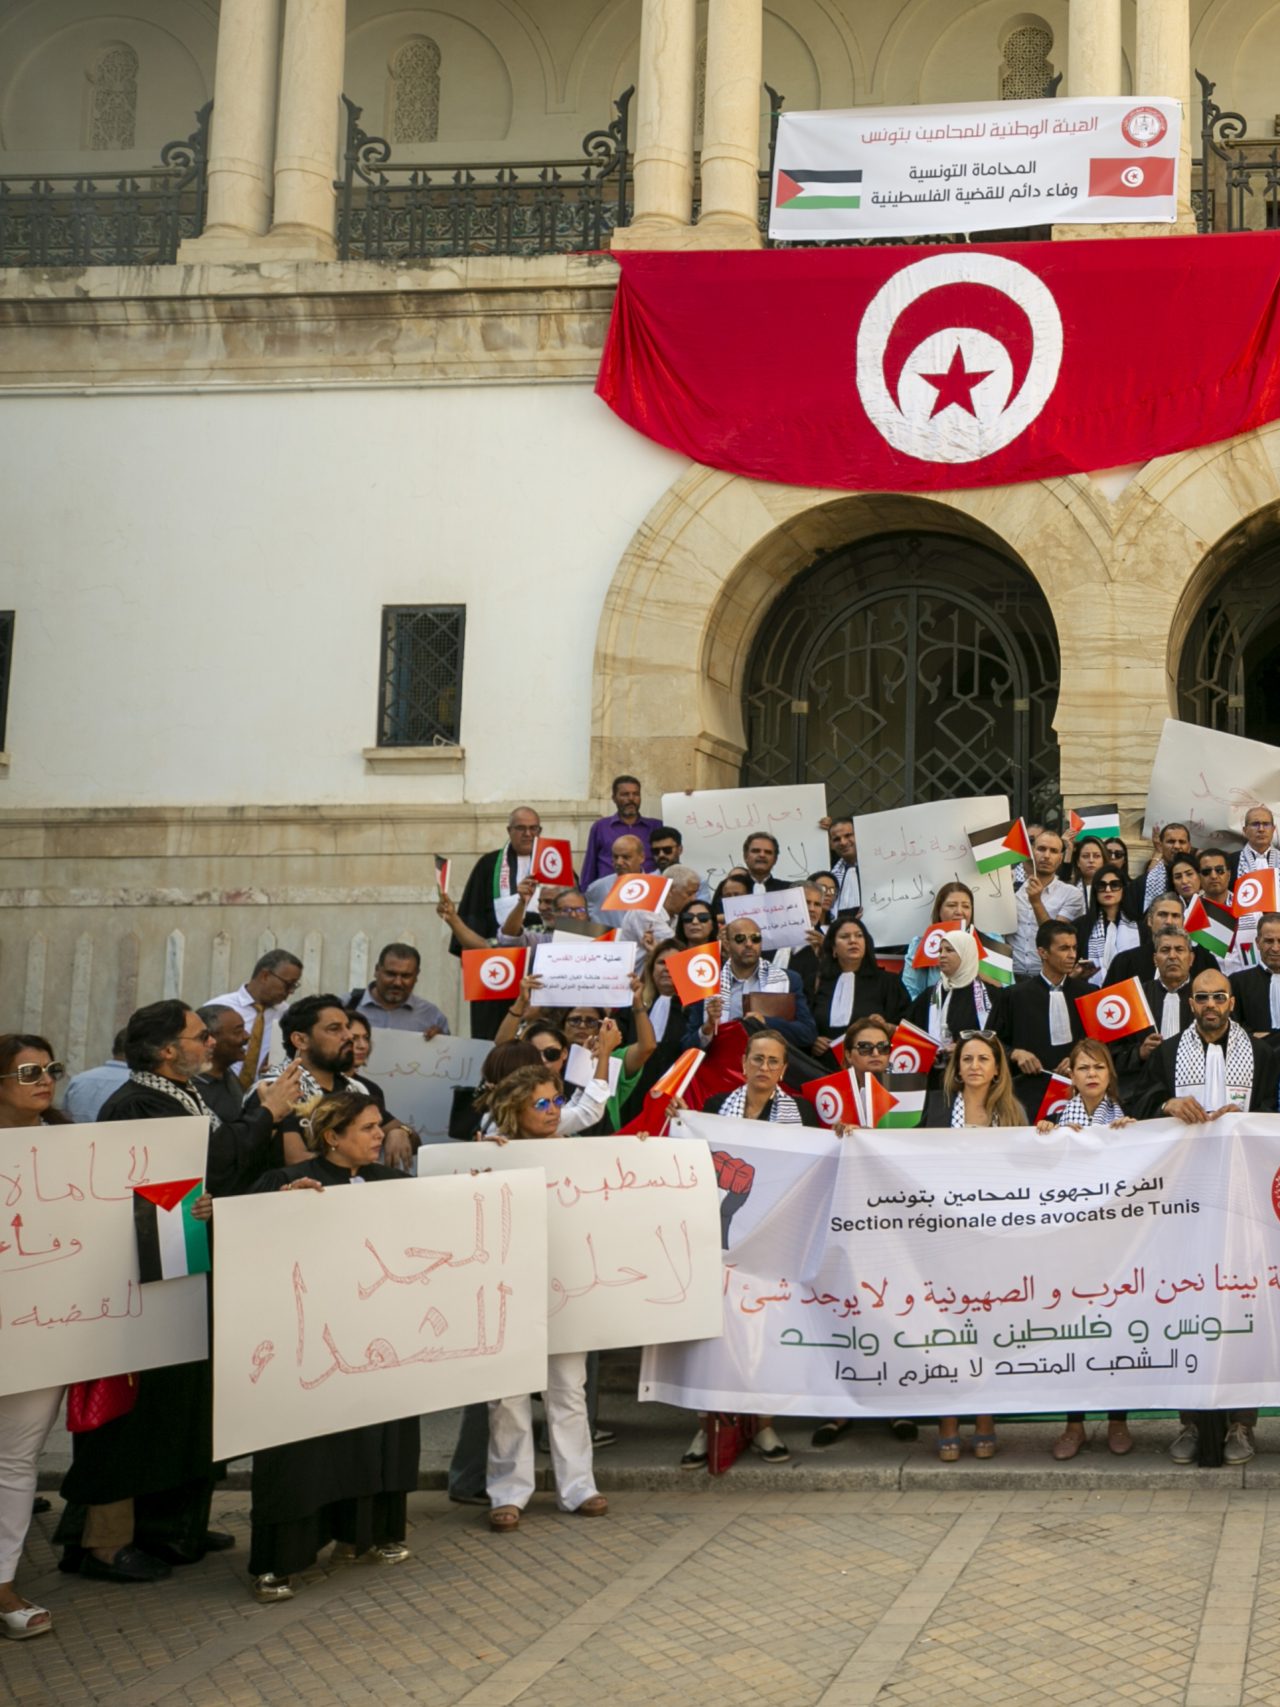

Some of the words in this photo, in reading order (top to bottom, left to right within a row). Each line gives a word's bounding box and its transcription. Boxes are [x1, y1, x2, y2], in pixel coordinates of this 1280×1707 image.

[915, 123, 986, 143] للمحامين
[990, 119, 1049, 139] الوطنية
[1052, 116, 1099, 136] الهيئة
[861, 128, 911, 146] بتونس
[908, 164, 967, 183] التونسية
[972, 161, 1037, 178] المحاماة
[871, 189, 950, 208] الفلسطينية
[955, 186, 1005, 205] للقضية
[1009, 184, 1041, 202] دائم
[1046, 183, 1079, 199] وفاء
[943, 1187, 1031, 1207] للمحامين
[1039, 1182, 1109, 1206] الجهوي
[1114, 1176, 1164, 1198] الفرع
[867, 1189, 936, 1208] بتونس
[831, 1215, 903, 1233] Section
[908, 1211, 996, 1233] régionale
[1002, 1210, 1036, 1227] des
[1041, 1206, 1117, 1225] avocats
[1121, 1203, 1145, 1219] de
[1149, 1199, 1200, 1217] Tunis
[1072, 1266, 1145, 1308] العرب
[1154, 1273, 1205, 1304] نحن
[1215, 1264, 1258, 1299] بيننا
[896, 1292, 915, 1316] و
[924, 1275, 1035, 1314] الصهيونية
[1042, 1288, 1062, 1309] و
[893, 1318, 978, 1354] شعب
[993, 1313, 1113, 1349] فلسطين
[1128, 1319, 1149, 1343] و
[969, 1357, 983, 1378] لا
[994, 1353, 1075, 1376] المتحد
[899, 1364, 958, 1387] يهزم
